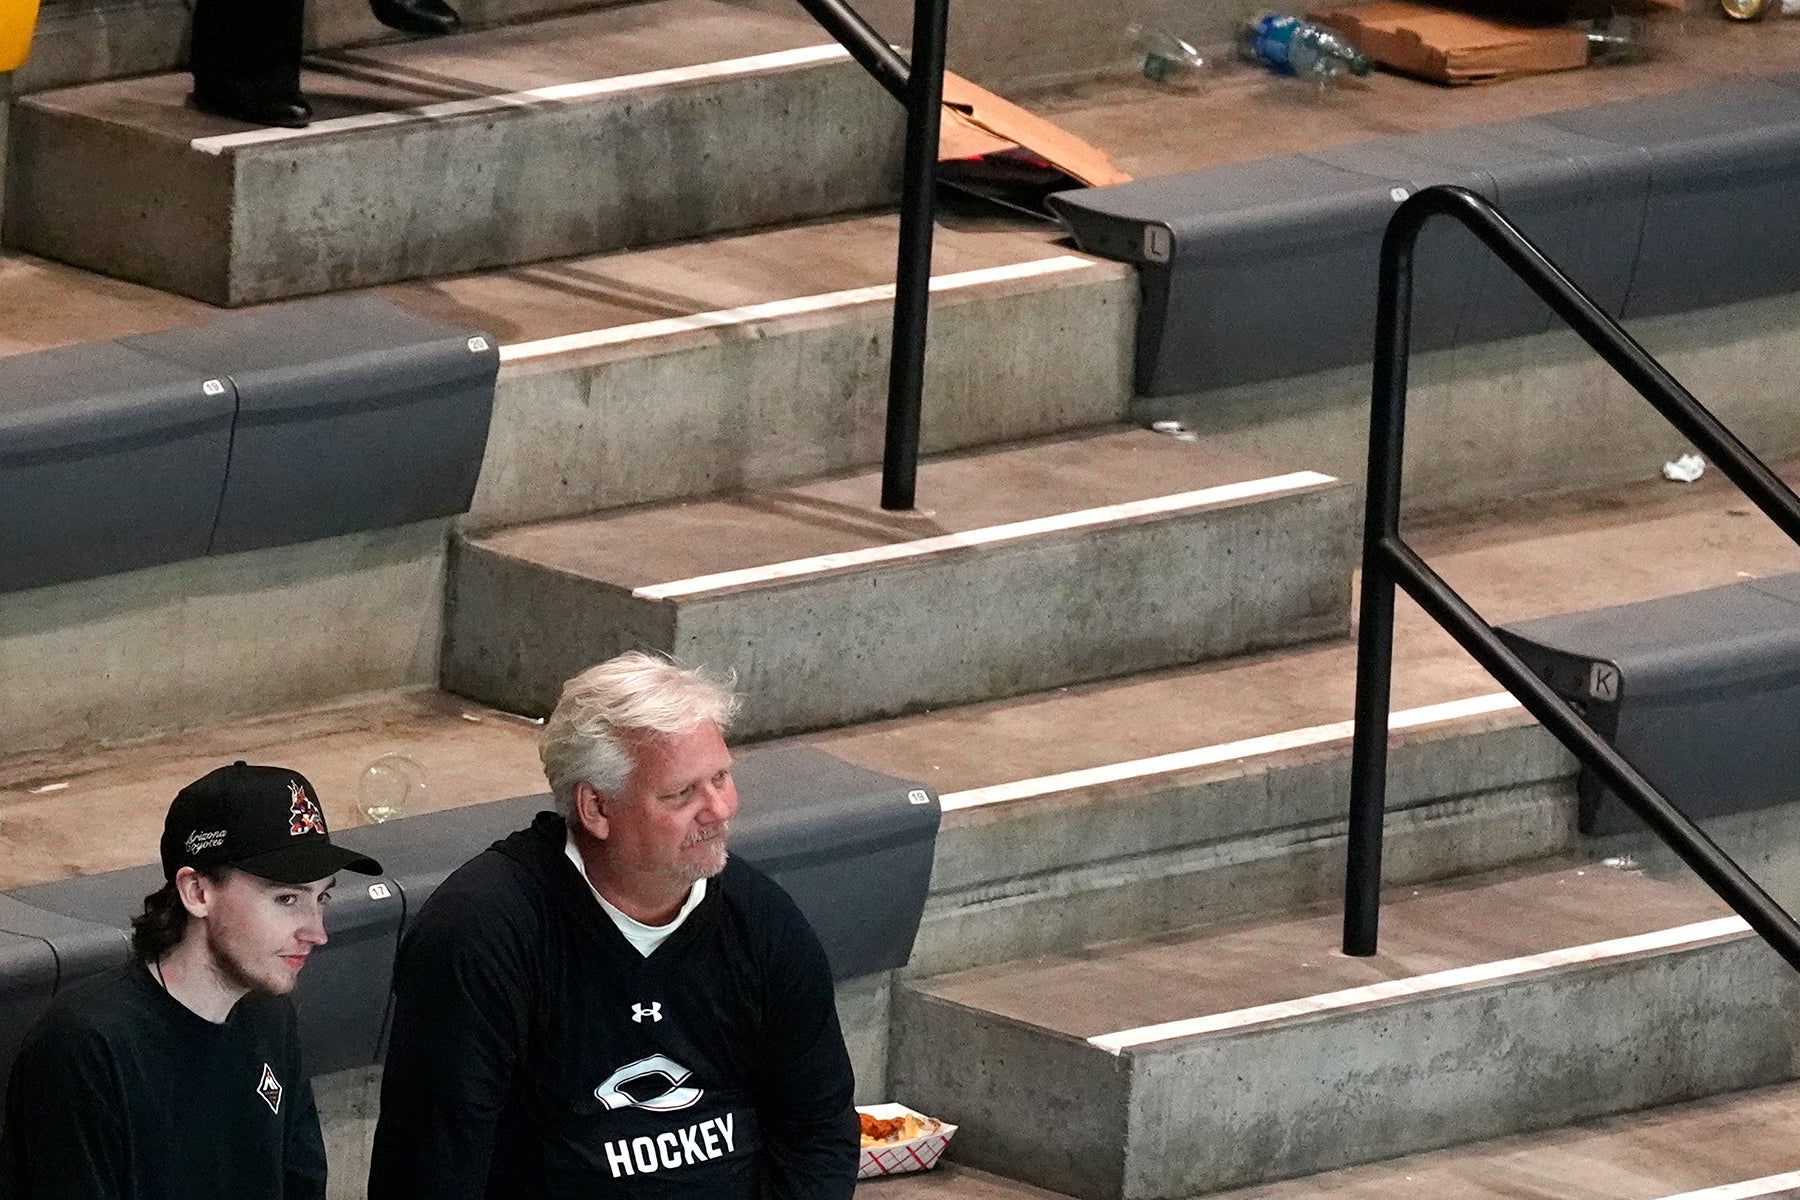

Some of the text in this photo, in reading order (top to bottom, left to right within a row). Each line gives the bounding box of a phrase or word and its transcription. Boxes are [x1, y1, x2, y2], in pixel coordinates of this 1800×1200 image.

[185, 829, 228, 845] Arizona
[184, 838, 224, 855] Coyotes
[604, 1112, 735, 1178] HOCKEY
